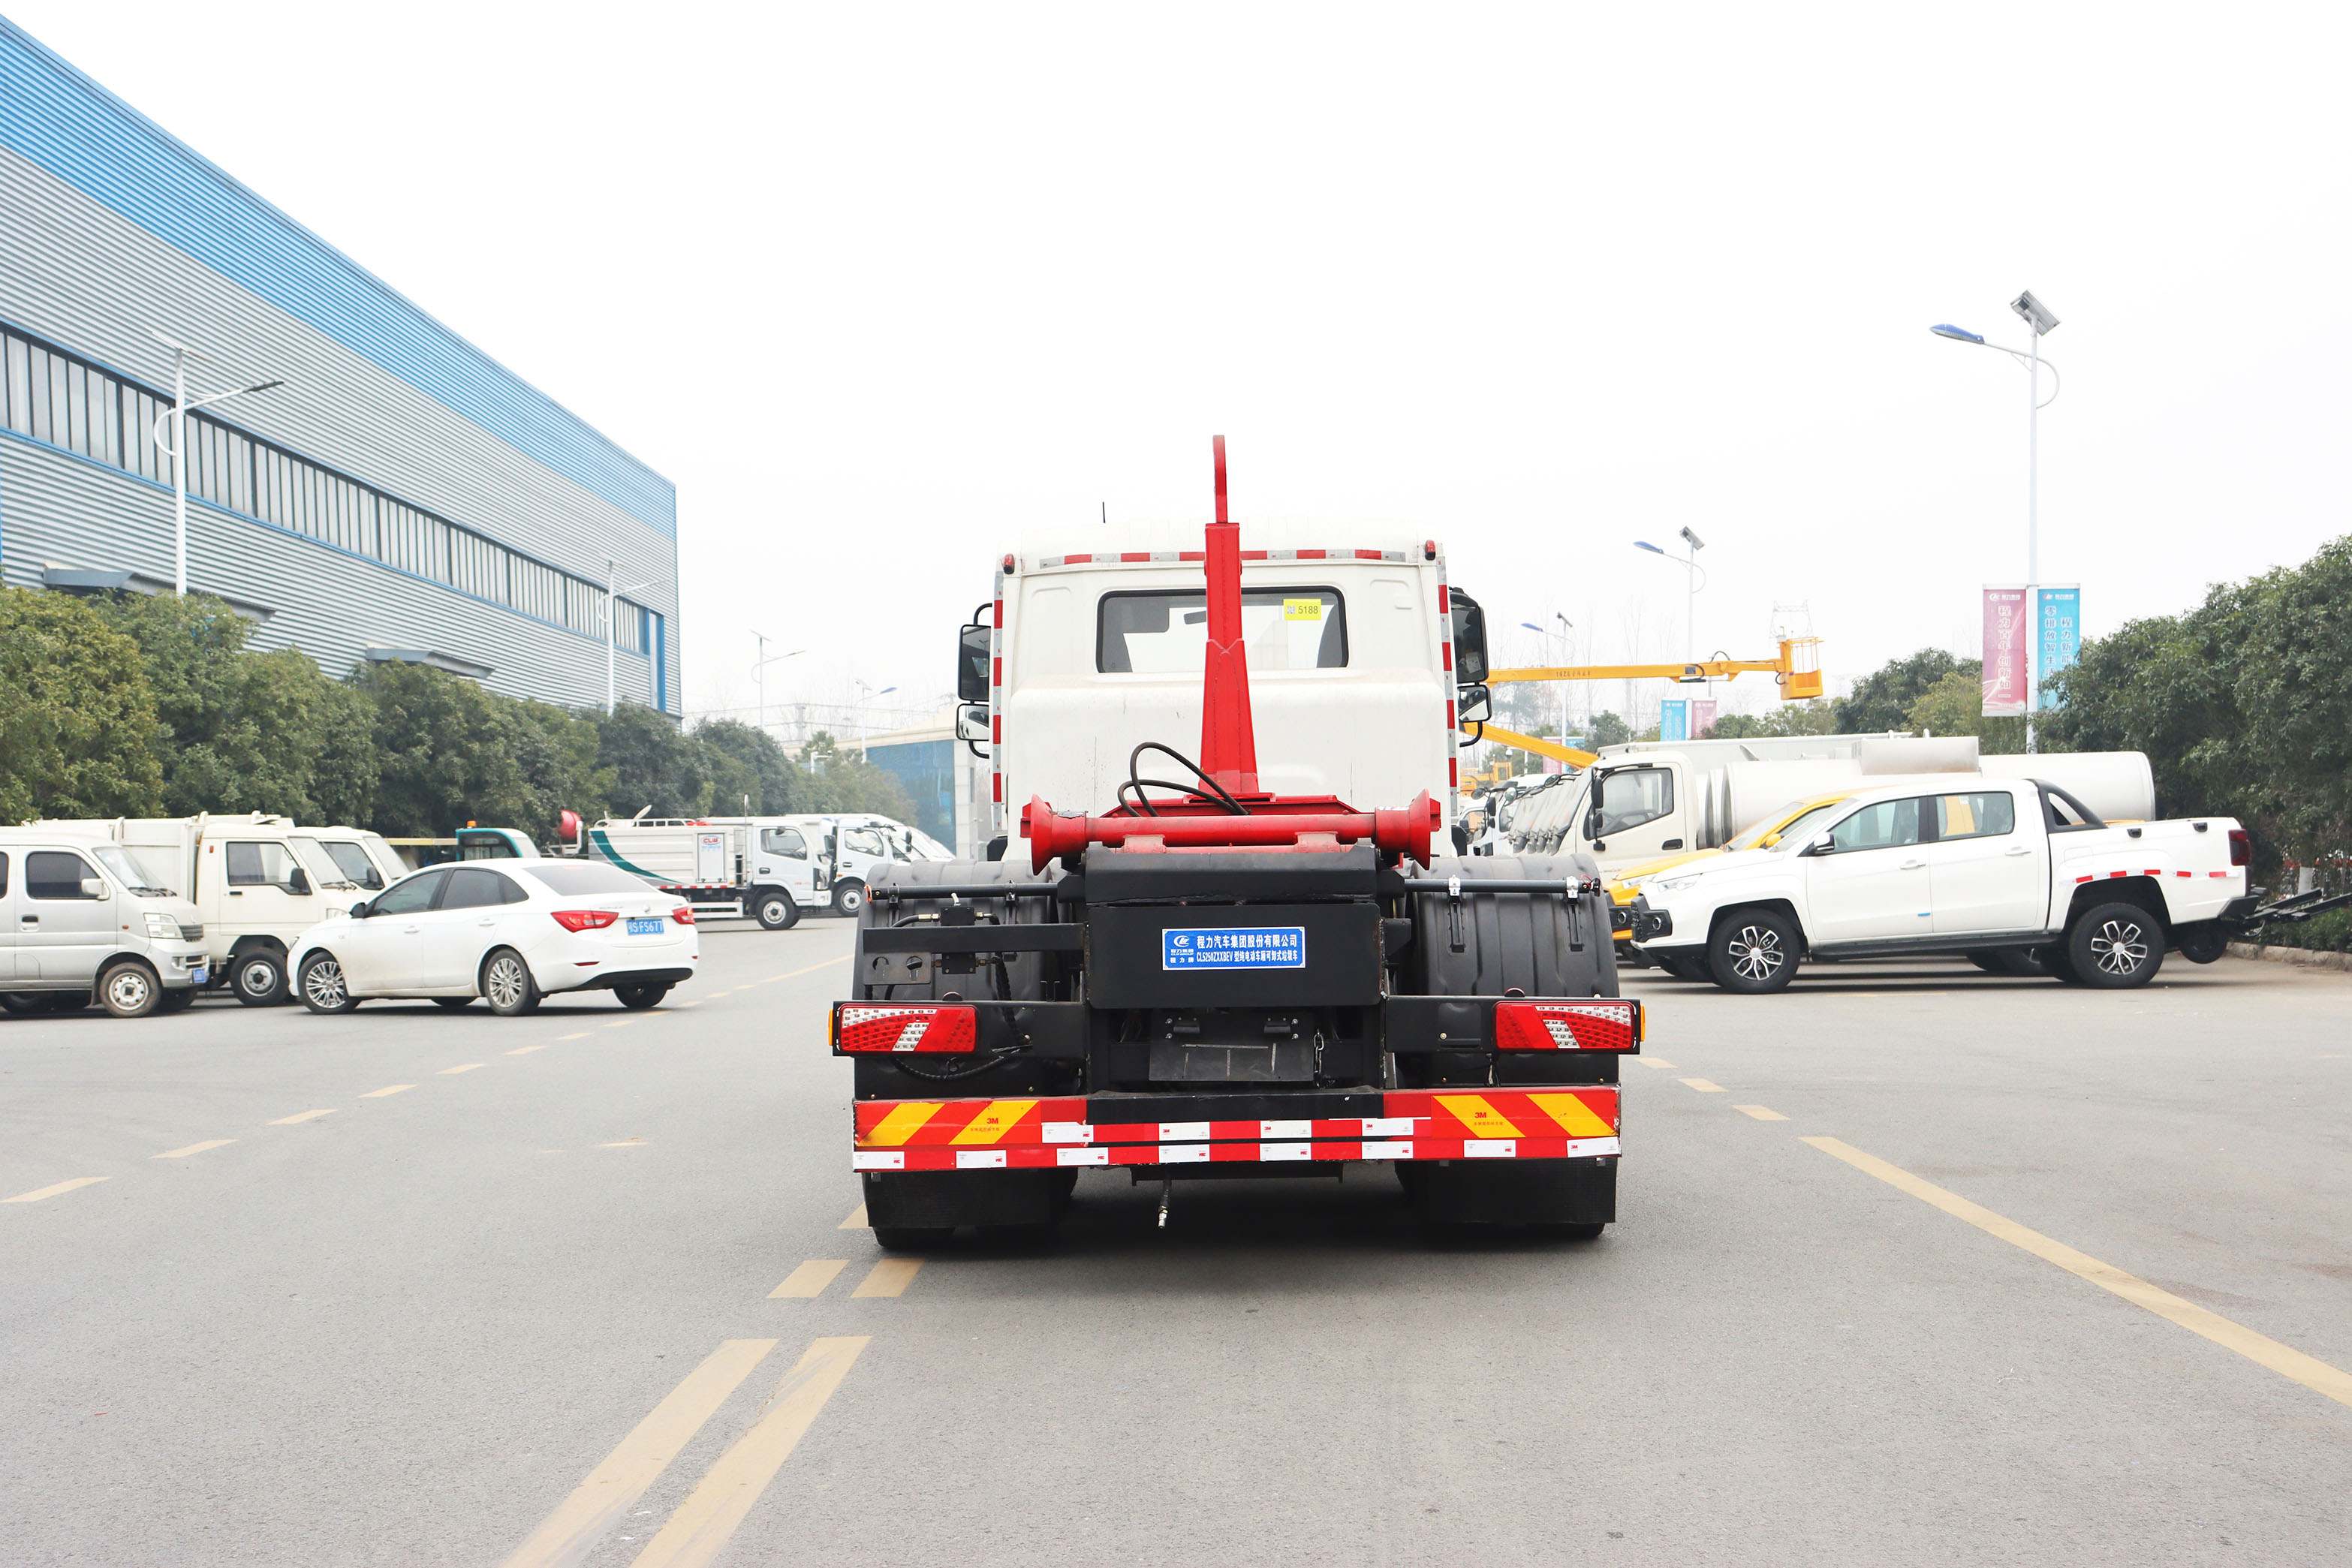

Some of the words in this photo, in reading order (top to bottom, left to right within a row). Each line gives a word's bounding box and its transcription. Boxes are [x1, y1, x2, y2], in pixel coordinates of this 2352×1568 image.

[1298, 606, 1318, 614] 5188
[2060, 617, 2073, 670] 程力新能
[1197, 934, 1297, 949] 程力汽车集团股份有限公司
